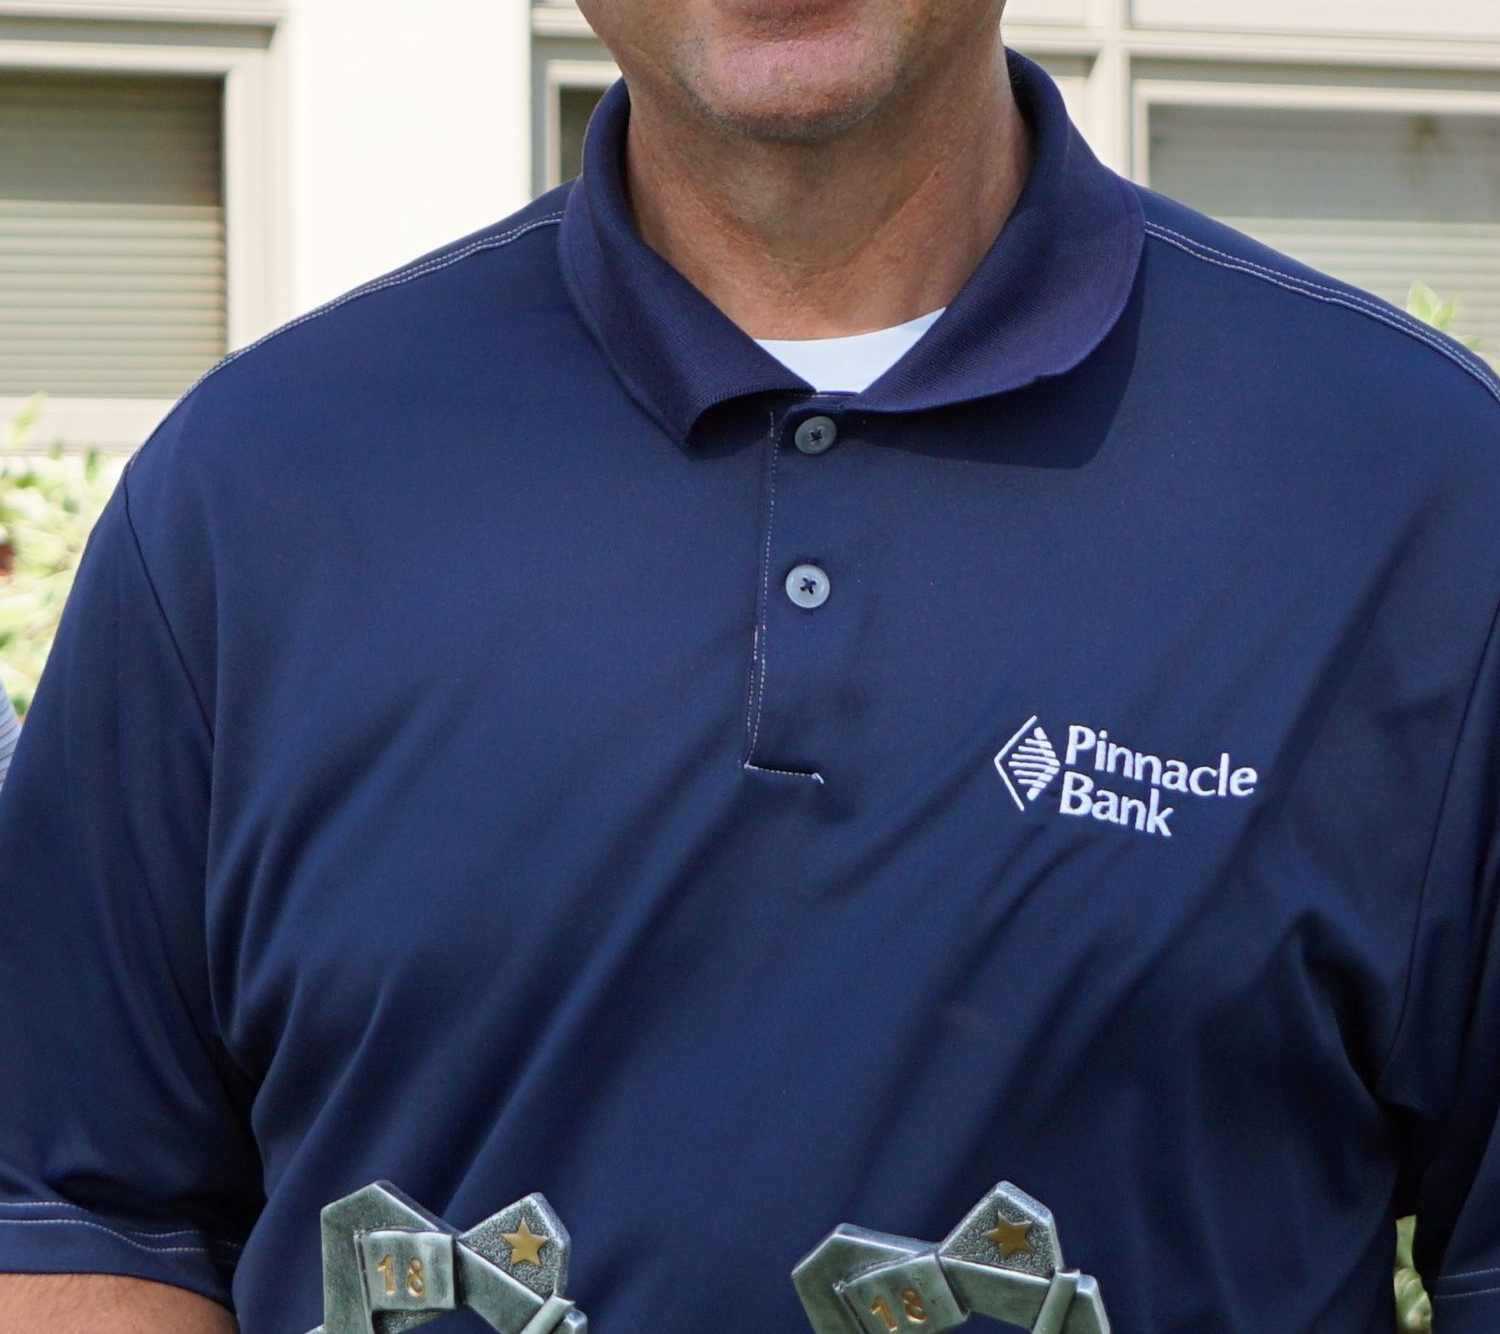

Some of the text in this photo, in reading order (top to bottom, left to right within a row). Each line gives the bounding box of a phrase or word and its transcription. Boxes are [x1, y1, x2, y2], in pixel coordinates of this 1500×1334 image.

[1064, 724, 1258, 797] Pinnacle
[1059, 771, 1174, 837] Bank
[375, 1253, 426, 1299] 18
[869, 1287, 929, 1333] 18
